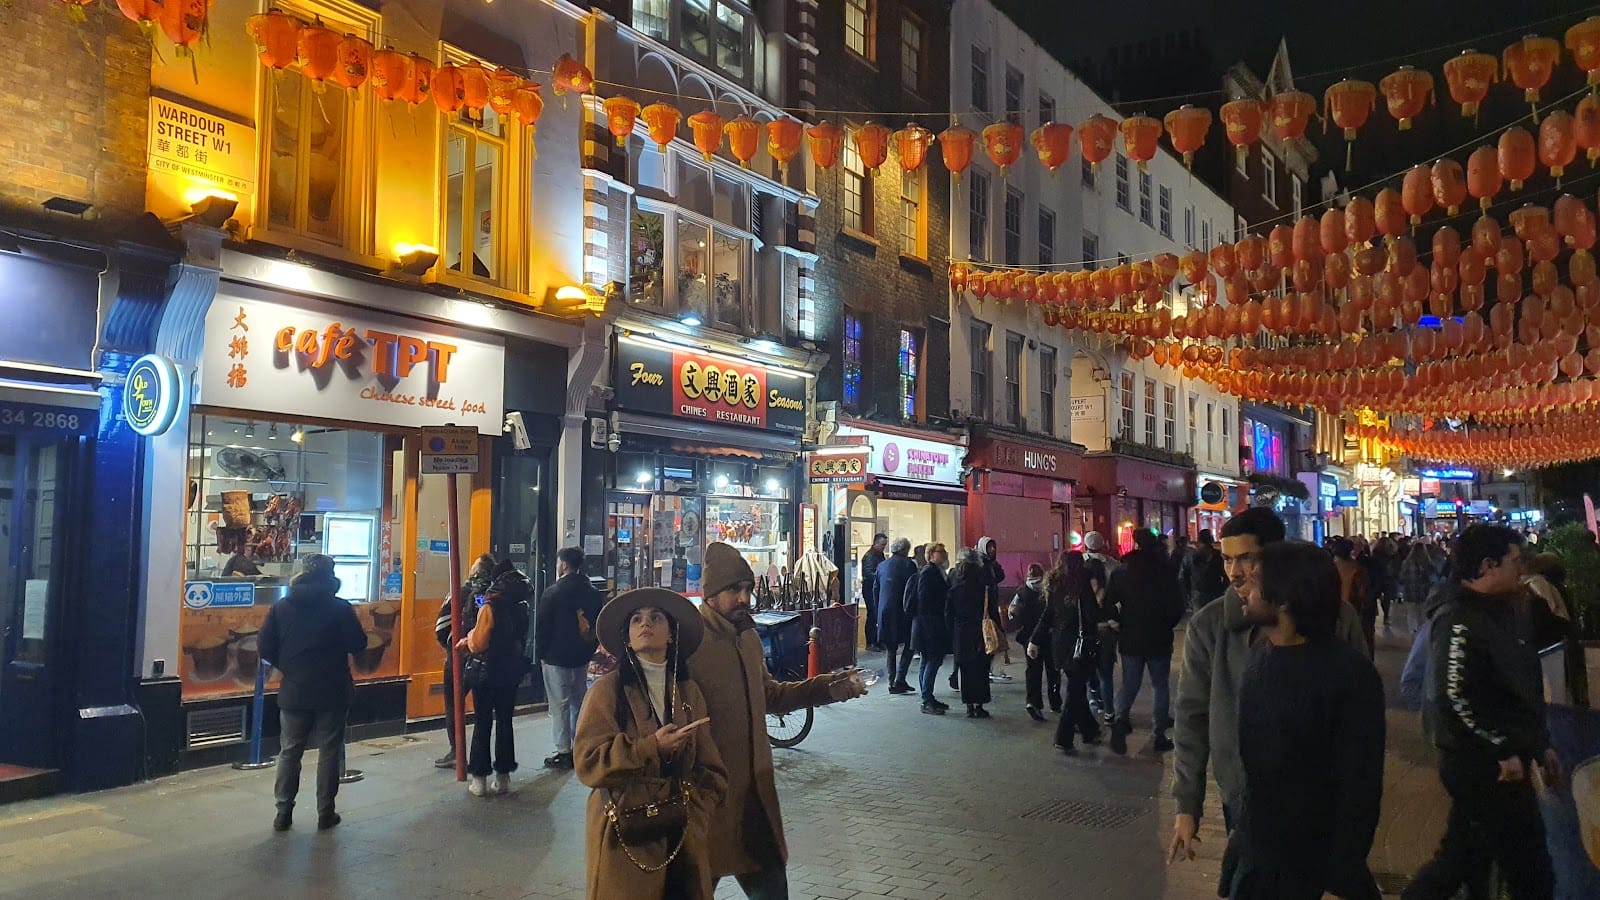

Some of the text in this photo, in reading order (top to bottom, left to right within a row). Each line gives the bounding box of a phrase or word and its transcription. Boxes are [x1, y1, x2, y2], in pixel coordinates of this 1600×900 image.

[158, 104, 225, 137] WARDOUR
[157, 121, 231, 155] STREET W1
[157, 138, 208, 165] 華都街
[156, 160, 170, 169] CITY
[181, 166, 224, 184] WESTMINSTER
[276, 322, 458, 383] café TPT
[629, 362, 665, 387] Four
[683, 365, 757, 405] 文興酒家
[360, 386, 486, 416] Chinese street food
[768, 390, 804, 411] Seasons
[32, 411, 80, 430] 2868
[716, 410, 761, 425] RESTAURANT
[1024, 450, 1057, 472] HUNG'S
